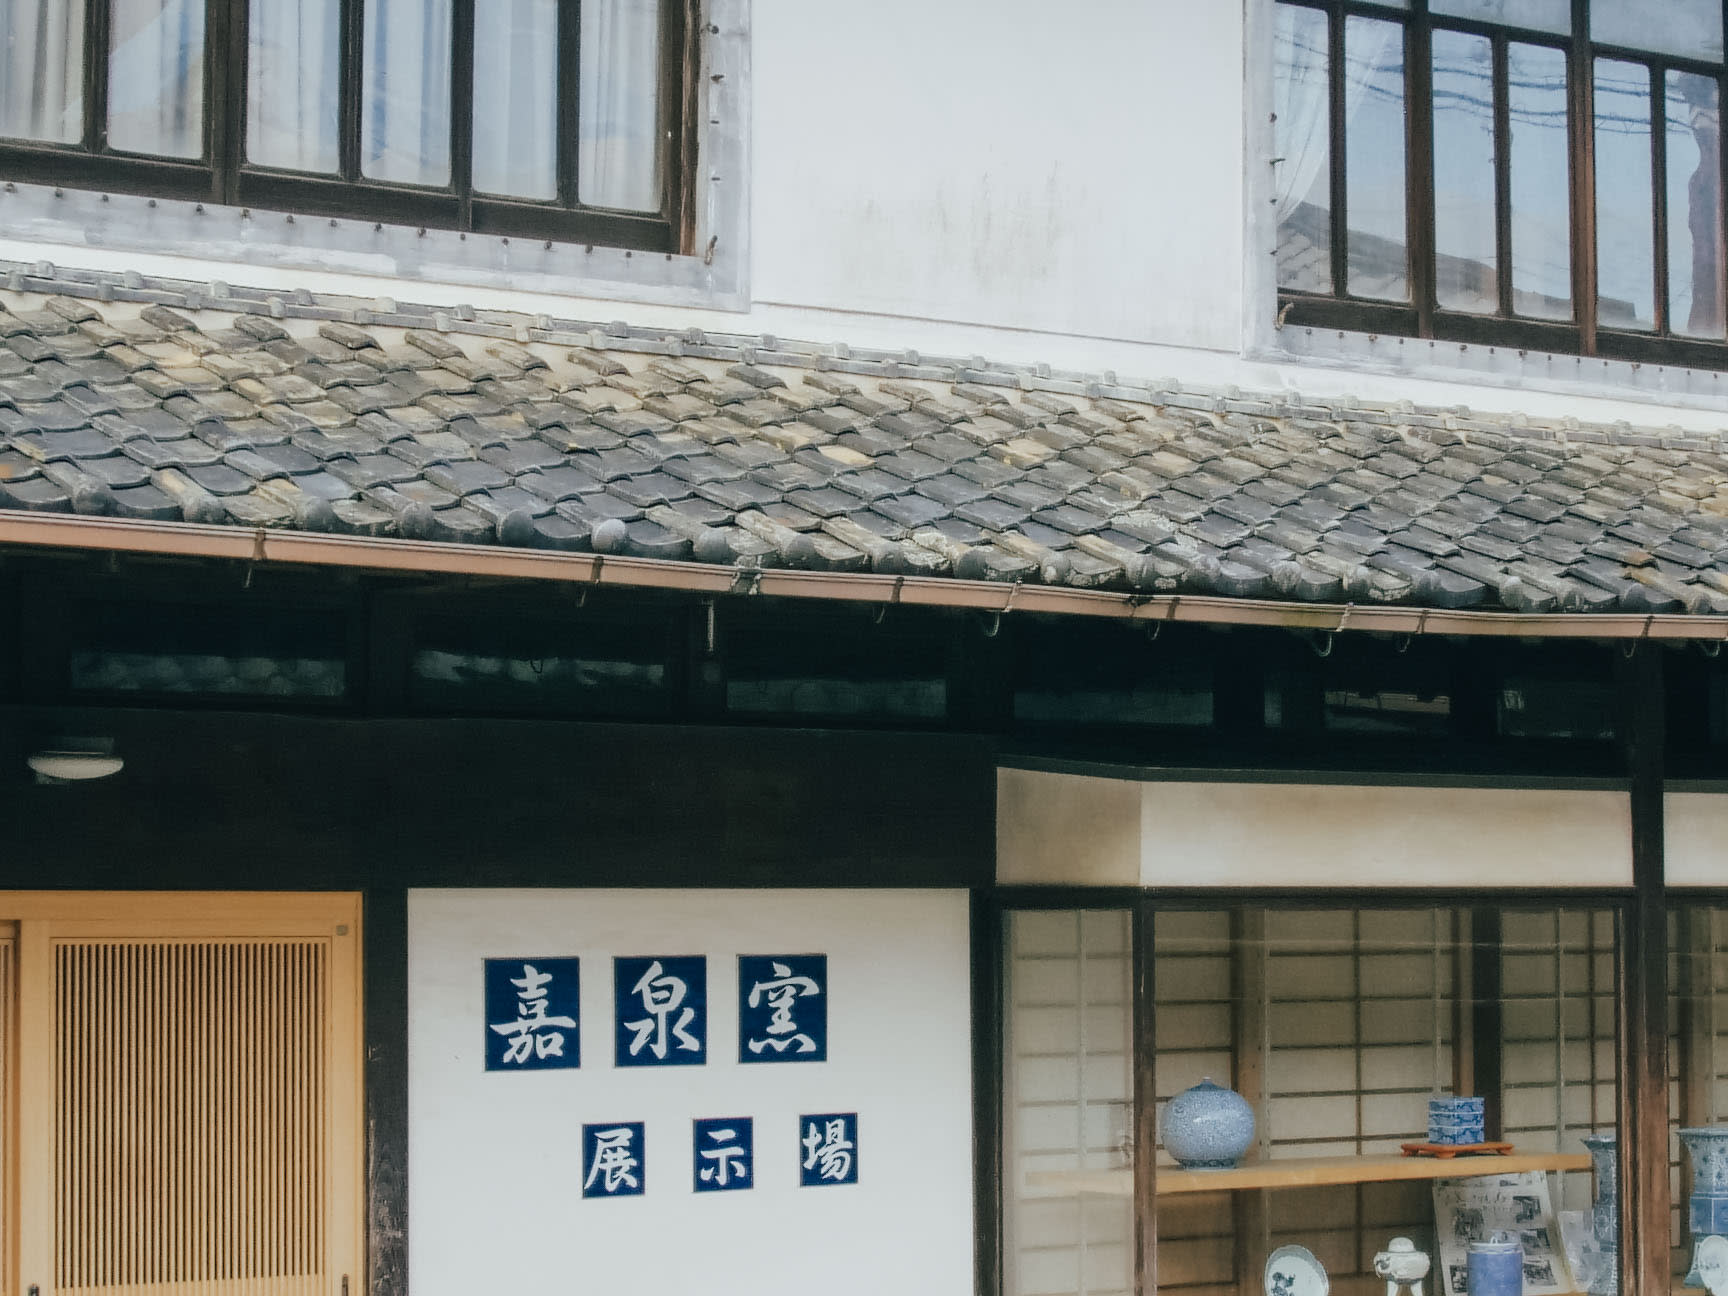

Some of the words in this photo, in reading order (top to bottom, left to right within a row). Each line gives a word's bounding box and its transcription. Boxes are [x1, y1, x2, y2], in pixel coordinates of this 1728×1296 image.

[489, 961, 820, 1064] 嘉泉窯
[583, 1118, 854, 1191] 展示場
